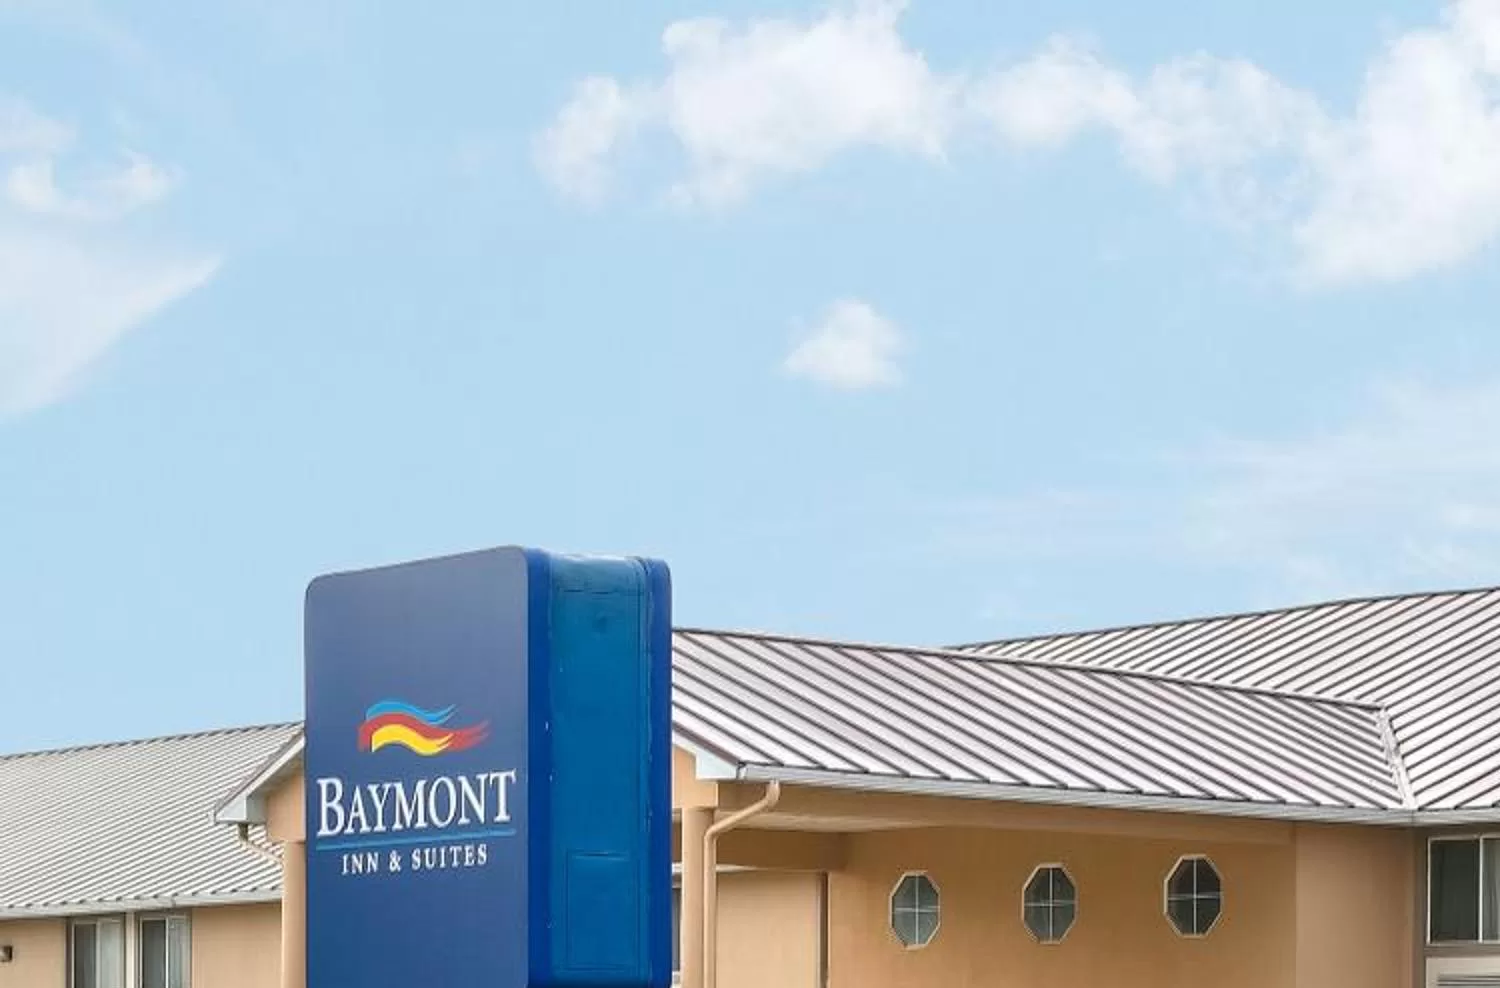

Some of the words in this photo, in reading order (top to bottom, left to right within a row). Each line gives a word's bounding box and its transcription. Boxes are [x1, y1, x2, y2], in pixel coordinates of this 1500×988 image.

[316, 768, 516, 837] BAYMONT
[341, 852, 379, 875] INN
[389, 851, 402, 873] &
[411, 843, 488, 871] SUITES
